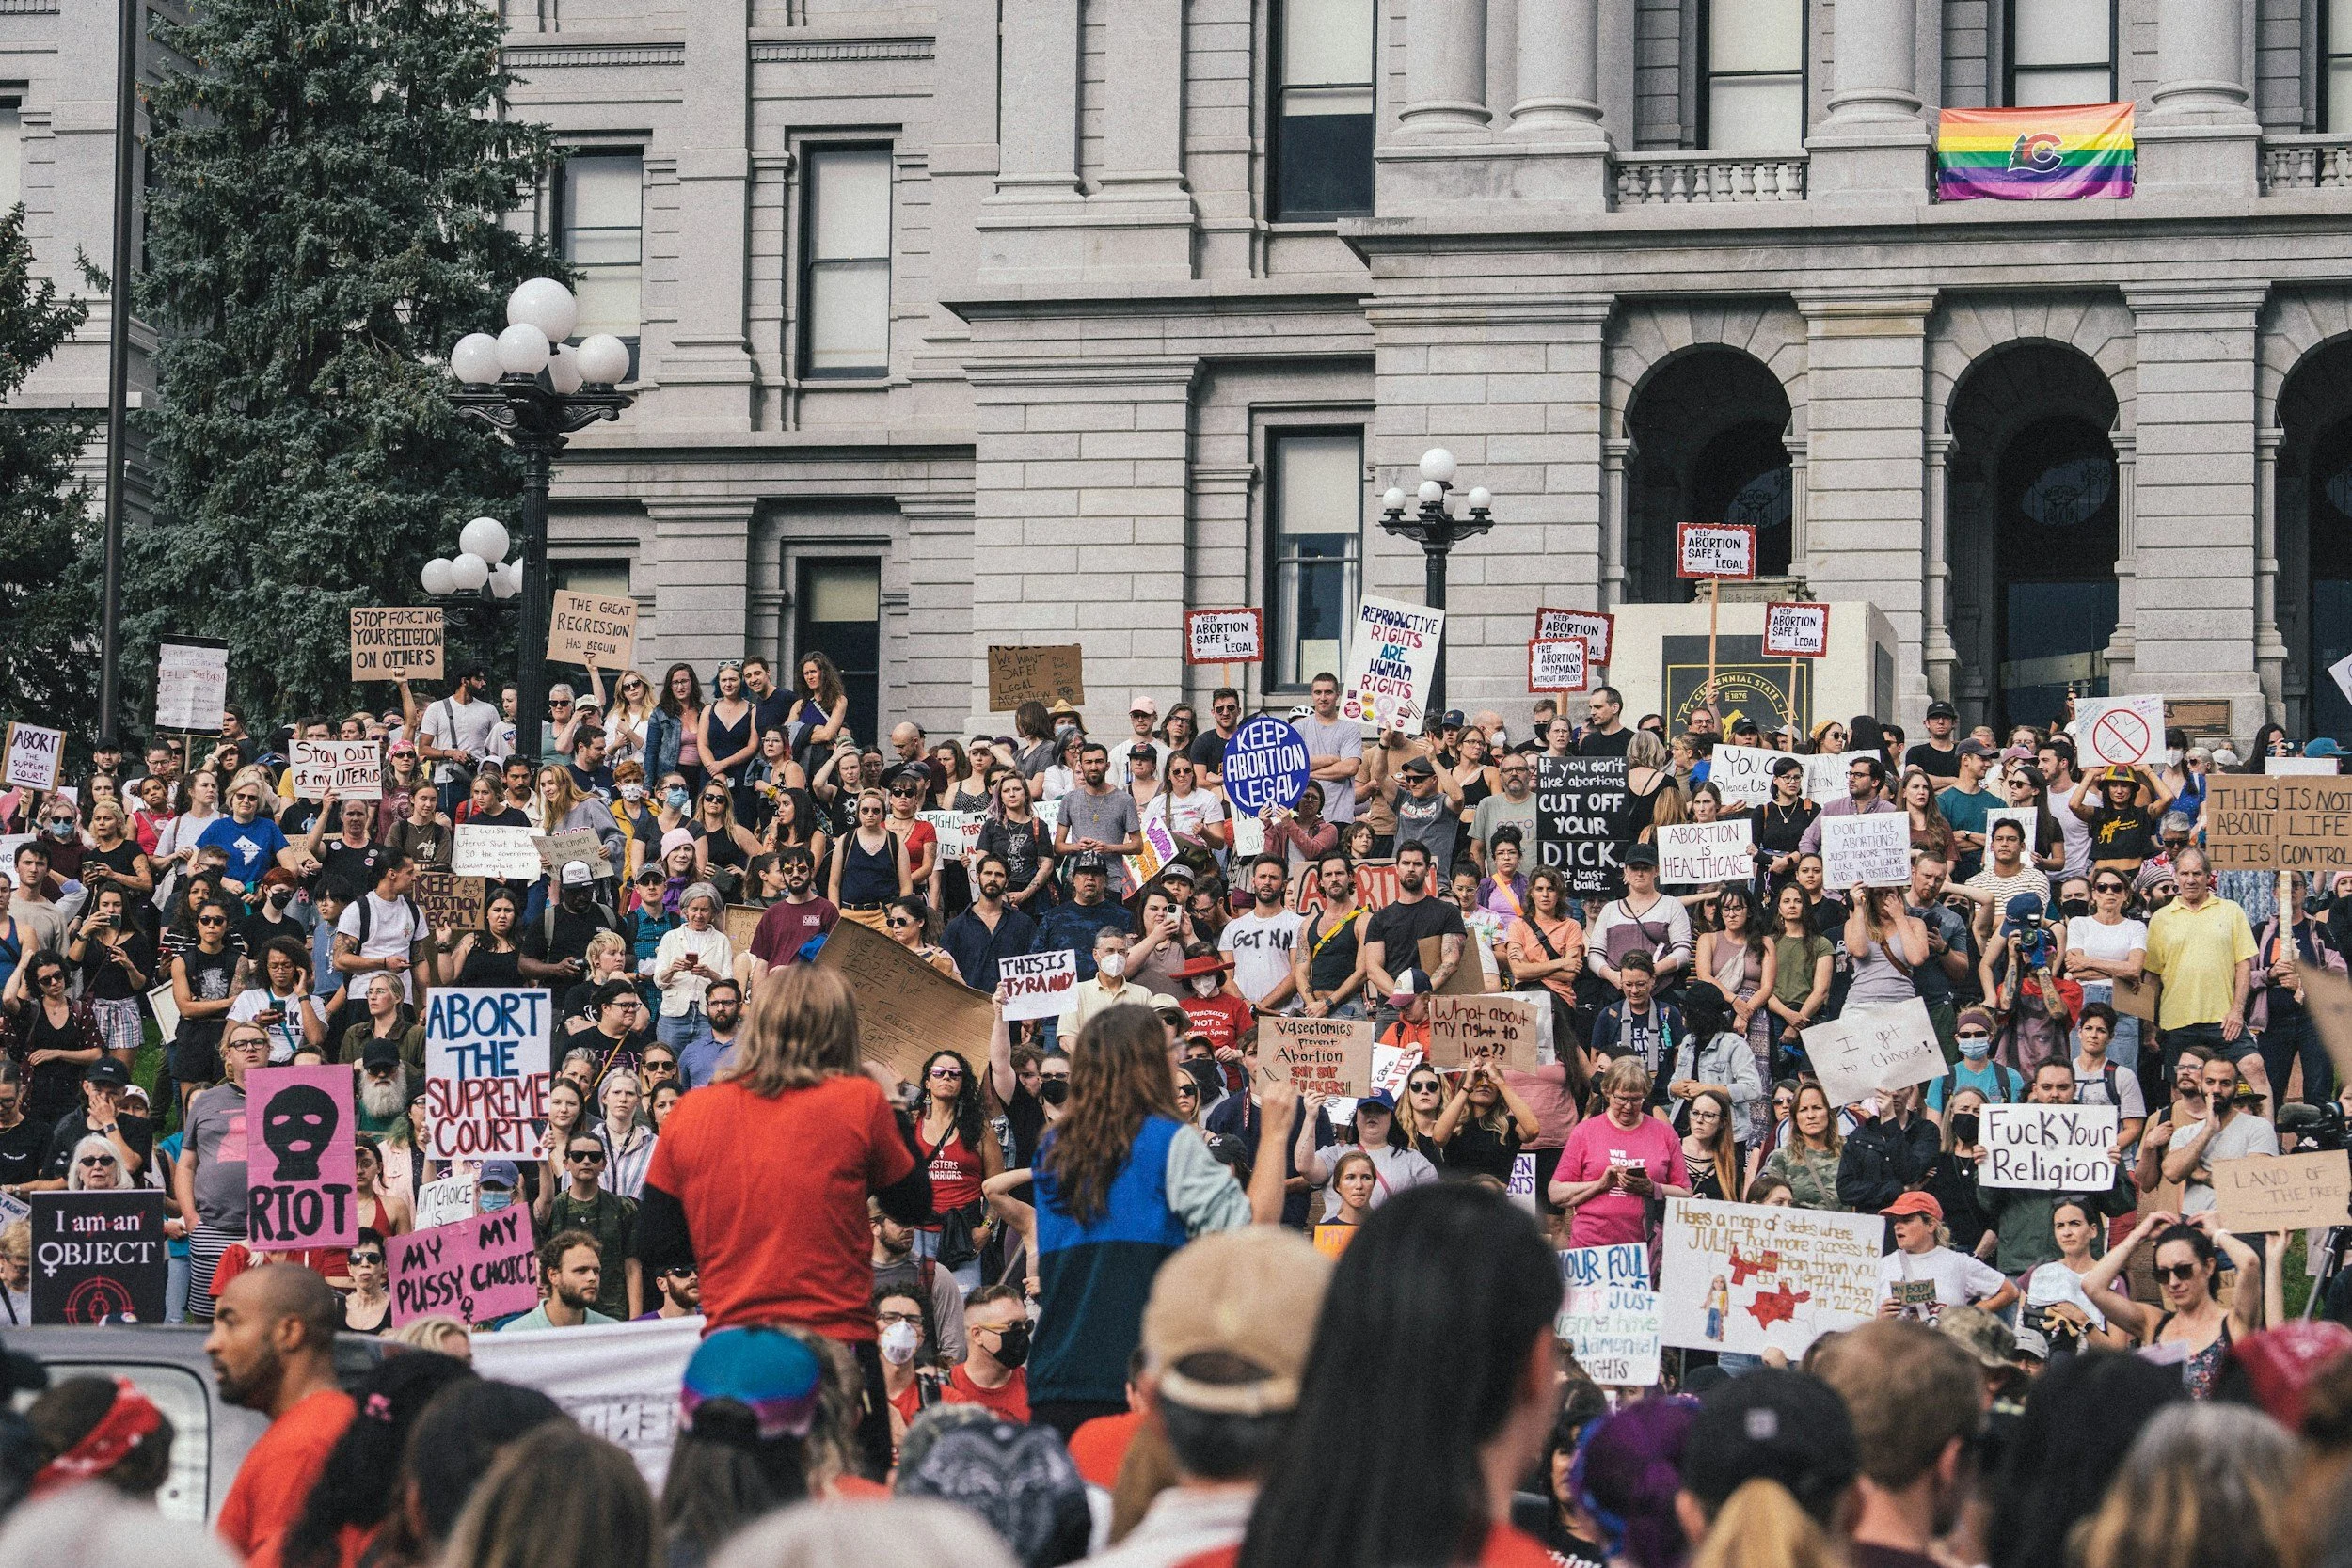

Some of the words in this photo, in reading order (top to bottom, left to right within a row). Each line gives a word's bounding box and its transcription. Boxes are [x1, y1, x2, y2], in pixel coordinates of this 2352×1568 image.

[1688, 537, 1740, 549] ABORTION
[1688, 548, 1712, 558] SAFE
[1714, 549, 1721, 558] &
[1716, 560, 1744, 569] LEGAL
[568, 598, 592, 612] THE
[599, 602, 631, 615] GREAT
[353, 611, 387, 627] STOP
[389, 611, 442, 625] FORCING
[557, 613, 630, 638] REGRESSION
[1196, 622, 1248, 634] ABORTION
[1361, 605, 1439, 635] REPRODUCTIVE
[1772, 616, 1816, 626] ABORTION
[353, 628, 385, 646] YOUR
[387, 628, 441, 646] RELIGION
[1371, 624, 1423, 649] RIGHTS
[1546, 621, 1599, 636] ABORTION
[1772, 626, 1793, 636] SAFE
[1794, 627, 1800, 636] &
[565, 638, 581, 649] HAS
[587, 641, 616, 654] BEGUN
[1197, 634, 1221, 644] SAFE
[1223, 634, 1230, 642] &
[1225, 642, 1254, 653] LEGAL
[1794, 637, 1819, 647] LEGAL
[1379, 643, 1408, 663] ARE
[1537, 644, 1553, 654] FREE
[357, 652, 376, 669] ON
[383, 650, 436, 669] OTHERS
[995, 653, 1011, 666] WE
[1016, 652, 1045, 664] WANT
[1541, 653, 1581, 664] ABORTION
[1541, 664, 1549, 673] ON
[1550, 664, 1581, 674] DEMAND
[999, 678, 1036, 694] LEGAL
[1360, 674, 1413, 699] RIGHTS
[1755, 679, 1780, 701] STATE
[11, 730, 59, 753] ABORT
[1237, 721, 1289, 752] KEEP
[25, 752, 39, 761] THE
[295, 741, 337, 768] Stay
[344, 745, 375, 761] OUT
[1226, 743, 1306, 783] ABORTION
[1724, 750, 1760, 777] YOU
[13, 759, 50, 772] SUPREME
[1539, 758, 1553, 773] If
[1560, 760, 1586, 778] you
[1590, 757, 1627, 773] don't
[15, 769, 46, 782] COURT.
[295, 770, 309, 785] of
[336, 767, 381, 786] UTERUS
[1540, 777, 1564, 789] like
[1568, 775, 1626, 787] abortions
[1712, 775, 1749, 792] Silence
[1235, 774, 1300, 807] LEGAL
[2212, 787, 2278, 810] THIS
[2284, 787, 2311, 810] IS
[1538, 793, 1581, 813] CUT
[1587, 793, 1625, 813] OFF
[927, 814, 961, 829] RIGHTS
[974, 814, 987, 823] MY
[1553, 816, 1610, 835] YOUR
[2217, 813, 2274, 835] ABOUT
[2289, 816, 2349, 836] LIFE
[460, 827, 469, 835] I
[516, 829, 530, 837] my
[1669, 824, 1740, 844] ABORTION
[1833, 822, 1865, 836] DON'T
[1872, 820, 1896, 833] LIKE
[1842, 832, 1899, 850] ABORTIONS?
[1543, 841, 1626, 868] DICK.
[1701, 845, 1711, 857] IS
[1828, 850, 1848, 861] JUST
[1852, 849, 1882, 858] IGNORE
[2210, 845, 2237, 862] IT
[2243, 843, 2270, 862] IS
[2281, 844, 2352, 864] CONTROL
[1663, 854, 1749, 879] HEALTHCARE
[1834, 863, 1854, 871] LIKE
[1860, 860, 1876, 868] YOU
[1881, 858, 1903, 866] IGNORE
[1578, 869, 1607, 880] least
[1833, 872, 1853, 882] KIDS
[414, 873, 461, 895] KEEP
[415, 893, 482, 911] ABORTION
[1002, 957, 1044, 975] THIS
[1043, 953, 1067, 971] IS
[426, 992, 547, 1040] ABORT
[1435, 998, 1486, 1022] What
[1489, 1007, 1529, 1026] about
[1276, 1021, 1353, 1037] Vasectomies
[1433, 1022, 1456, 1039] my
[1462, 1022, 1496, 1037] right
[1502, 1025, 1518, 1040] to
[1297, 1038, 1339, 1050] prevent
[1836, 1035, 1859, 1054] I
[1876, 1023, 1900, 1050] get
[1275, 1047, 1343, 1064] Abortion
[1463, 1042, 1506, 1060] live??
[445, 1040, 519, 1081] THE
[1838, 1064, 1858, 1074] to
[1291, 1066, 1314, 1078] SNIP
[1316, 1066, 1338, 1078] SNIP
[426, 1071, 550, 1119] SUPREME
[434, 1117, 549, 1158] COURT!
[2060, 1112, 2113, 1147] Your
[1609, 1148, 1626, 1159] WE
[1609, 1157, 1645, 1167] WON'T
[1993, 1148, 2109, 1190] Religion
[2234, 1168, 2290, 1188] LAND
[2306, 1165, 2328, 1180] OF
[2265, 1187, 2305, 1204] THE
[2310, 1186, 2343, 1198] FREE
[56, 1210, 65, 1232] I
[72, 1214, 106, 1233] am
[113, 1214, 141, 1232] an
[248, 1183, 352, 1243] RIOT
[432, 1211, 443, 1227] IS
[479, 1212, 517, 1250] MY
[1730, 1214, 1761, 1232] map
[1764, 1213, 1781, 1231] of
[1784, 1215, 1818, 1236] states
[1820, 1218, 1853, 1241] where
[1747, 1226, 1771, 1249] had
[1775, 1237, 1809, 1252] more
[1814, 1240, 1861, 1257] access
[1865, 1240, 1879, 1258] to
[402, 1235, 442, 1274] MY
[1608, 1245, 1649, 1280] FOUL
[471, 1250, 536, 1291] CHOICE
[1812, 1254, 1848, 1275] than
[1851, 1263, 1877, 1281] you
[397, 1265, 464, 1314] PUSSY
[1799, 1275, 1835, 1292] 1974
[1840, 1279, 1874, 1297] than
[1907, 1282, 1930, 1293] BODY
[1815, 1297, 1827, 1307] in
[1834, 1296, 1875, 1317] 2022
